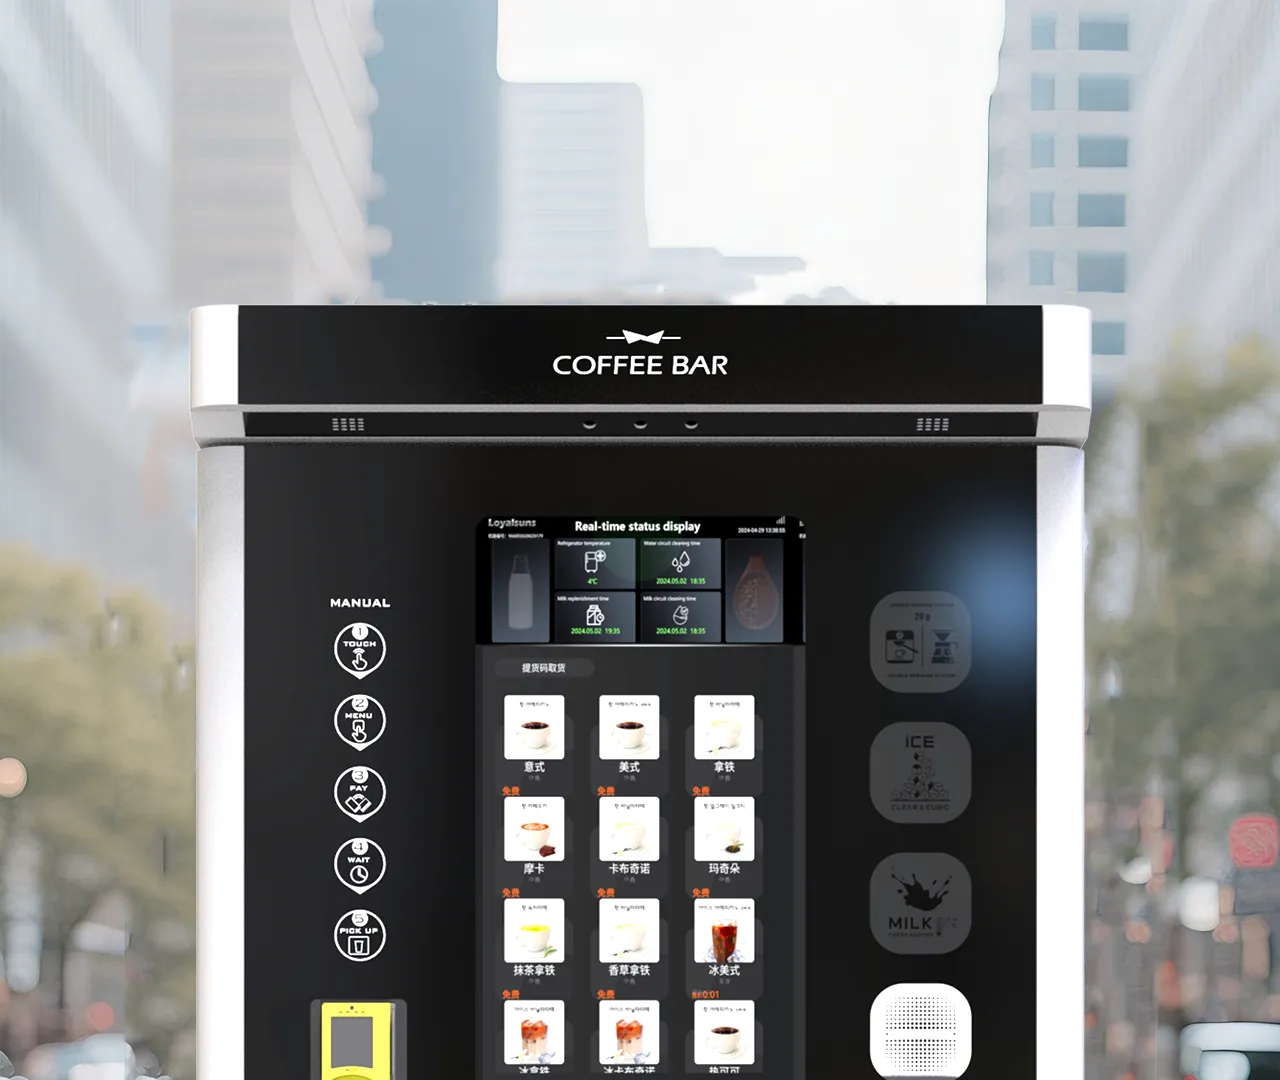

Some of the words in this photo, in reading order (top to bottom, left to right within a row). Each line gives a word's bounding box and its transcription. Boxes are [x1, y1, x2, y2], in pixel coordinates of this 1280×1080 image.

[552, 355, 664, 375] COFFEE
[672, 355, 728, 375] BAR
[488, 519, 536, 529] Loyalsuns
[575, 521, 626, 531] Real-time
[628, 521, 661, 531] status
[663, 521, 701, 534] display
[330, 598, 391, 608] MANUAL
[522, 663, 566, 673] 提货码取货
[524, 761, 545, 773] 意式
[619, 761, 640, 773] 美式
[714, 761, 735, 773] 拿铁
[502, 786, 520, 796] 免费
[597, 786, 615, 796] 免费
[692, 786, 710, 796] 免费
[524, 862, 545, 875] 摩卡
[609, 862, 650, 875] 卡布奇诺
[709, 862, 740, 875] 玛奇朵
[502, 888, 520, 897] 免费
[597, 888, 615, 897] 免费
[692, 888, 710, 897] 免费
[888, 917, 932, 930] MILK
[514, 964, 555, 976] 抹茶拿铁
[609, 964, 650, 976] 香草拿铁
[709, 964, 740, 976] 冰美式
[502, 990, 520, 999] 免费
[597, 990, 615, 999] 免费
